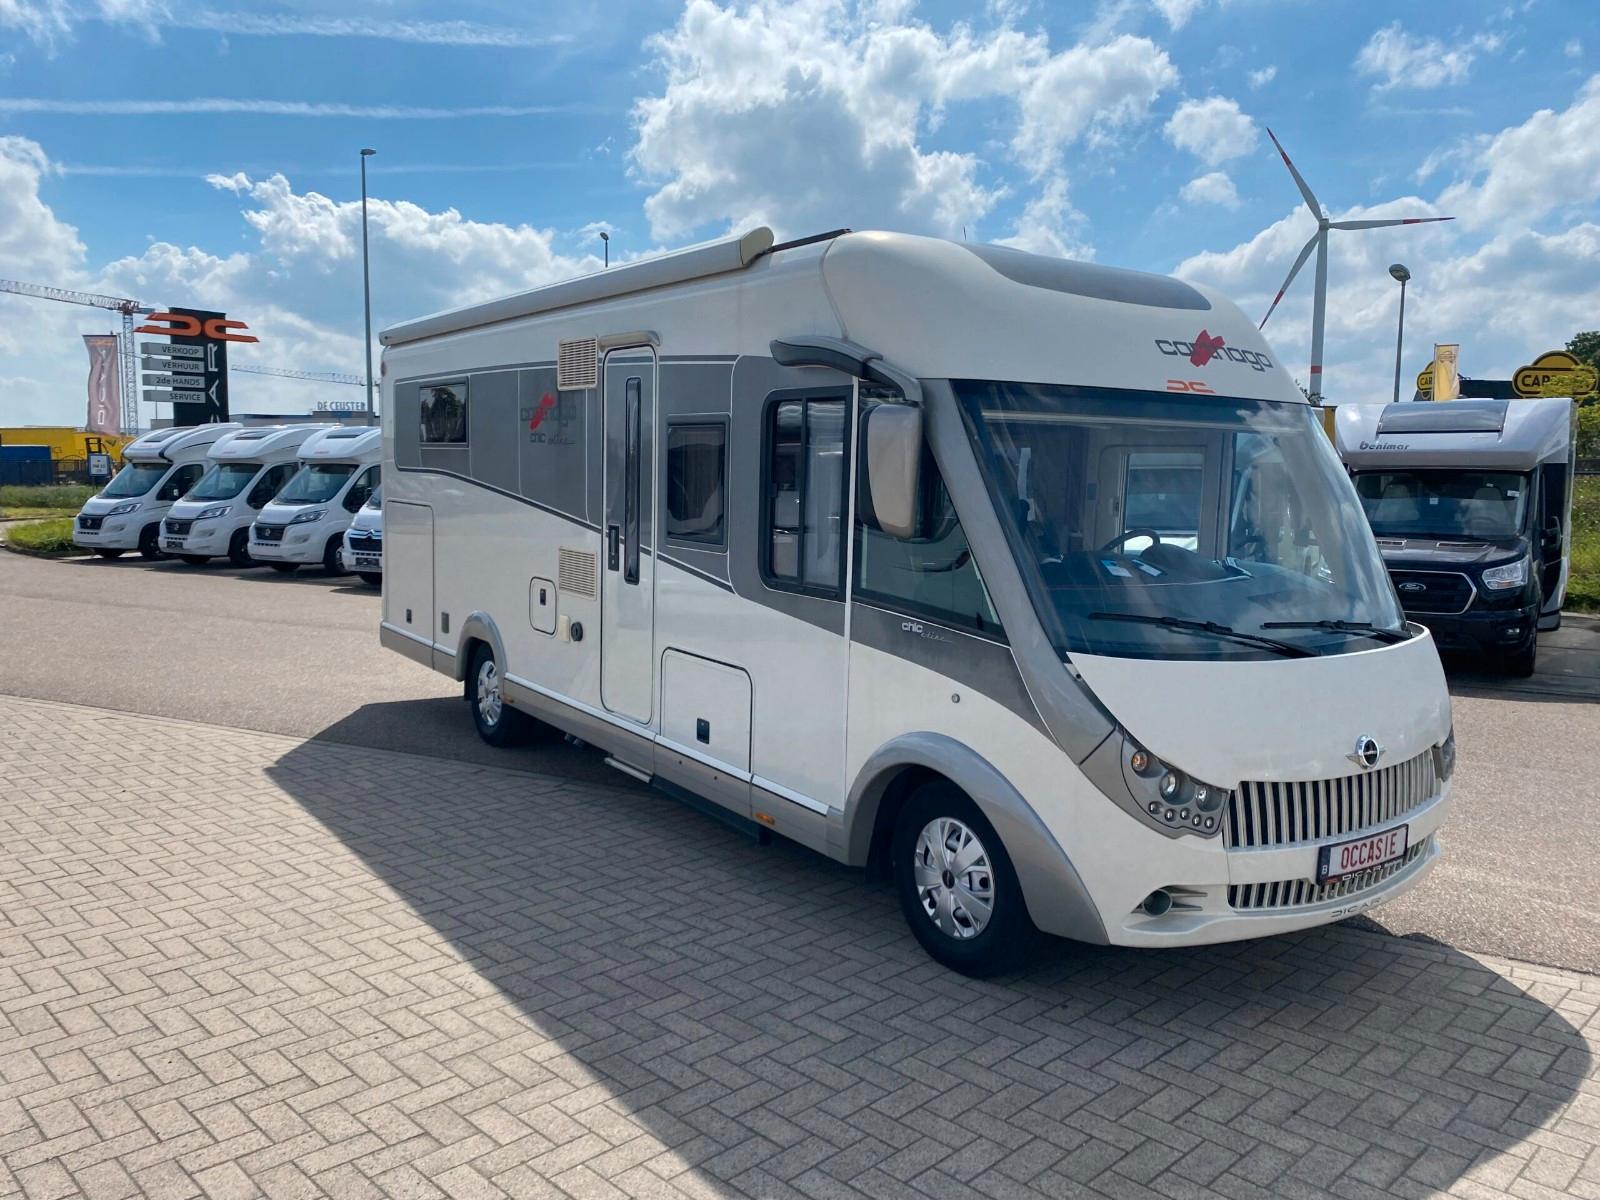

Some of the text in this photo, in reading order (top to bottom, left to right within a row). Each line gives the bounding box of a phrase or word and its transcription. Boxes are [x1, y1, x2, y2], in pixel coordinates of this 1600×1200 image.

[162, 345, 200, 356] VERKOOP
[1155, 339, 1274, 372] cahago
[162, 361, 200, 371] VERHUUR
[155, 375, 201, 387] 2de HANDS
[169, 392, 201, 401] SERVICE
[317, 401, 366, 411] DE CEUSTER
[901, 621, 924, 633] chic
[1341, 832, 1398, 870] OCCASIE
[1322, 864, 1328, 873] B
